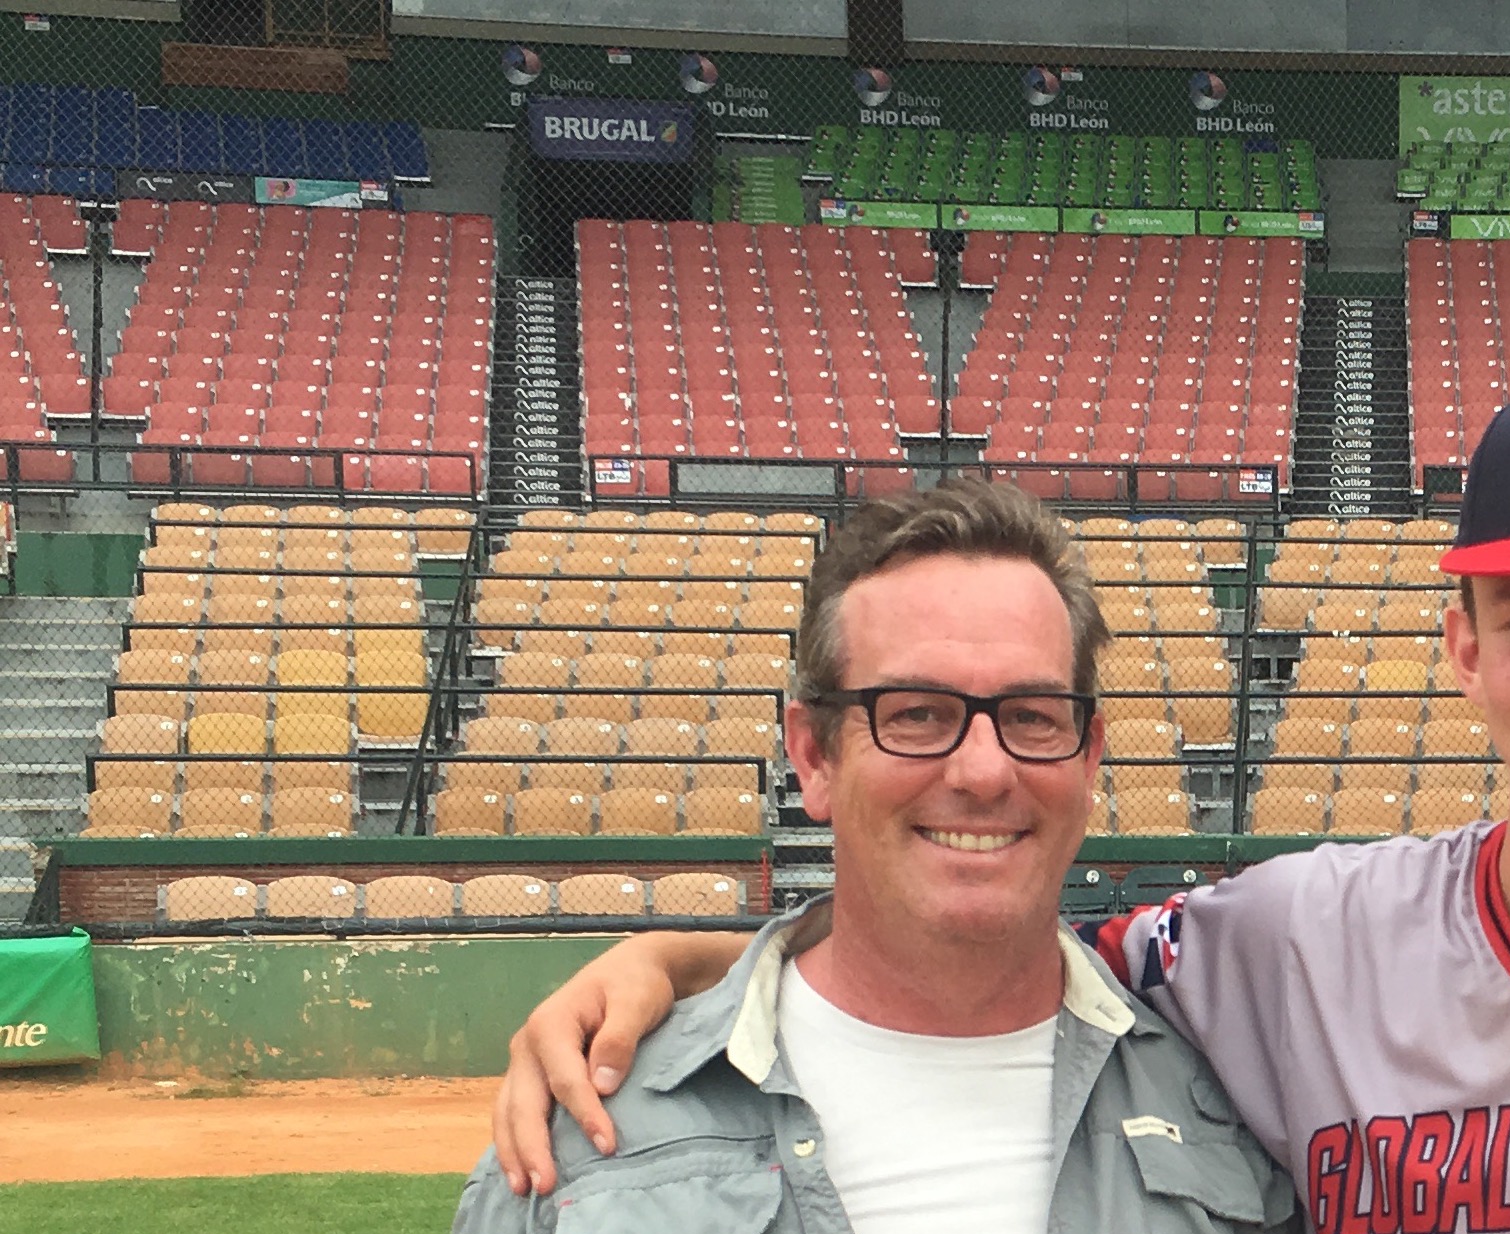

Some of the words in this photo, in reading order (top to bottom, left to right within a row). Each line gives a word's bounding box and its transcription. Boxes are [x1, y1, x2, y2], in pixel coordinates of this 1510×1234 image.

[725, 83, 769, 99] Banco
[1233, 99, 1275, 115] Banco
[860, 110, 898, 125] BHD
[901, 111, 941, 127] León
[1030, 113, 1067, 128] BHD
[1070, 114, 1109, 129] León
[544, 116, 656, 143] BRUGAL
[1196, 117, 1233, 132] BHD
[1236, 118, 1275, 134] León
[1349, 417, 1374, 425] altice
[531, 453, 559, 461] altice
[1345, 453, 1370, 461] altice
[527, 468, 558, 476] altice
[530, 482, 560, 490] altice
[528, 495, 558, 503] altice
[1344, 492, 1371, 500] altice
[1342, 505, 1370, 513] altice
